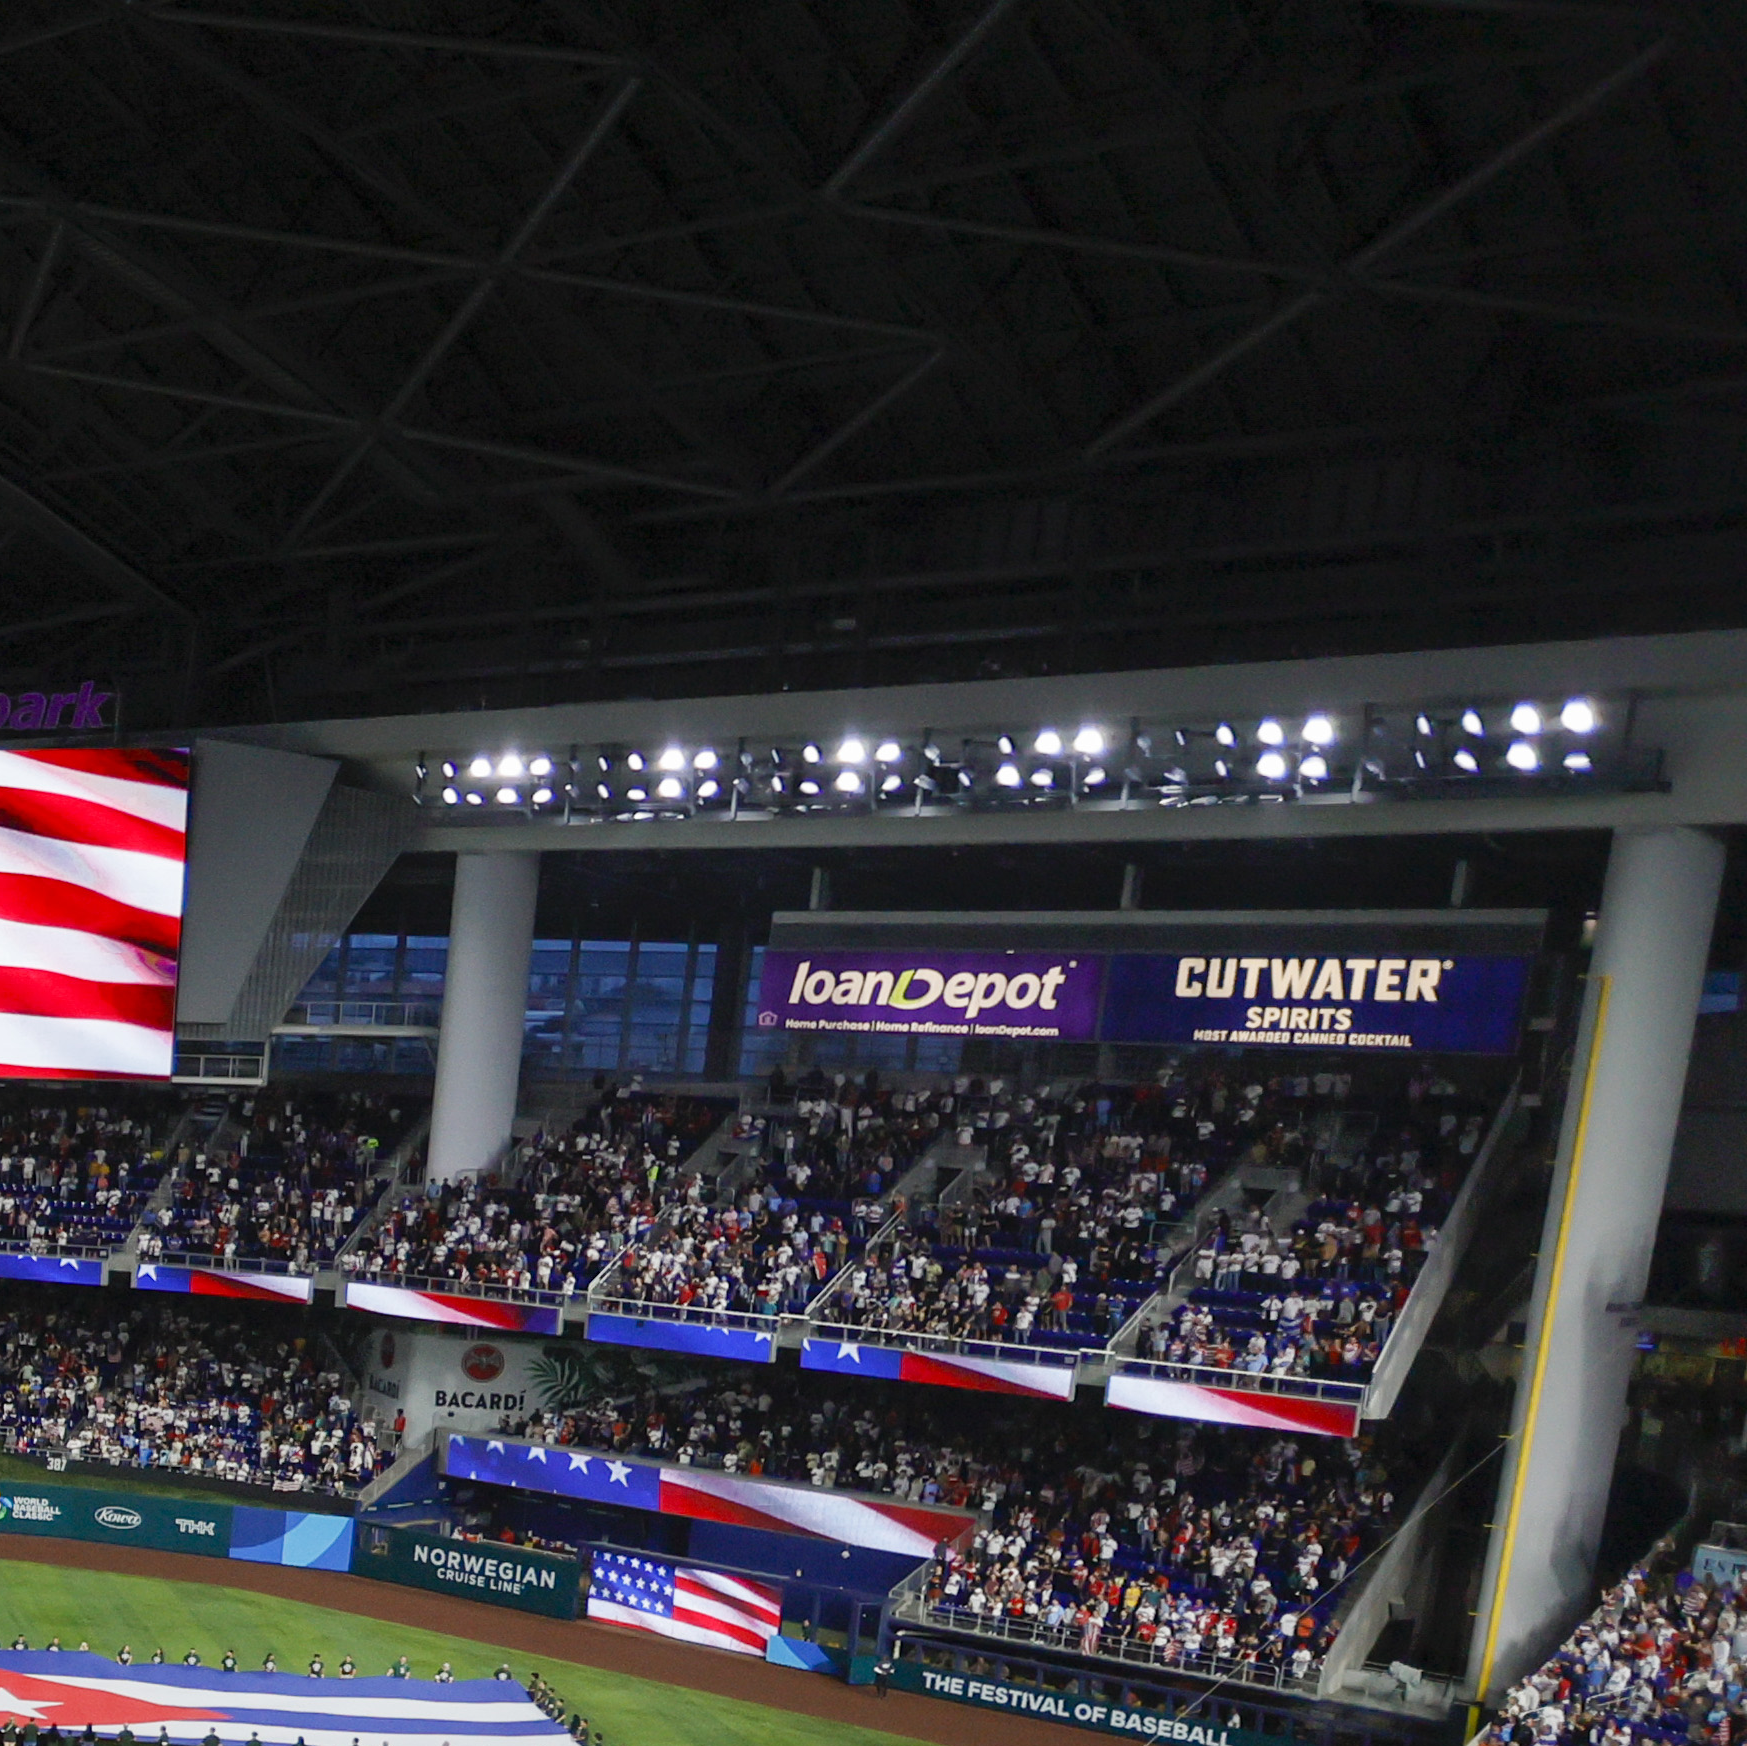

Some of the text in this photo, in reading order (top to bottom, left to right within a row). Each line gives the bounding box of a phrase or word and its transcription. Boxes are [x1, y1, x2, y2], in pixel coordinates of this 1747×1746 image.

[1174, 957, 1441, 1002] CUTWATER
[787, 960, 1067, 1019] loanDepot
[1245, 1006, 1353, 1031] SPIRITS
[786, 1019, 1059, 1037] Home Purchase Home Refinance loanDepot.com
[1193, 1029, 1412, 1047] MOST AWARDED CANNED COCKTAIL
[47, 1457, 67, 1472] 387
[13, 1496, 49, 1507] WORLD
[13, 1504, 61, 1516] BASEBALL
[98, 1508, 140, 1525] Kowa
[175, 1518, 215, 1536] THK
[414, 1544, 556, 1589] NORWEGIAN
[437, 1567, 521, 1595] CRUISE LINE
[923, 1672, 964, 1696] THE
[967, 1681, 1070, 1718] FESTIVAL
[1074, 1704, 1107, 1723] OF
